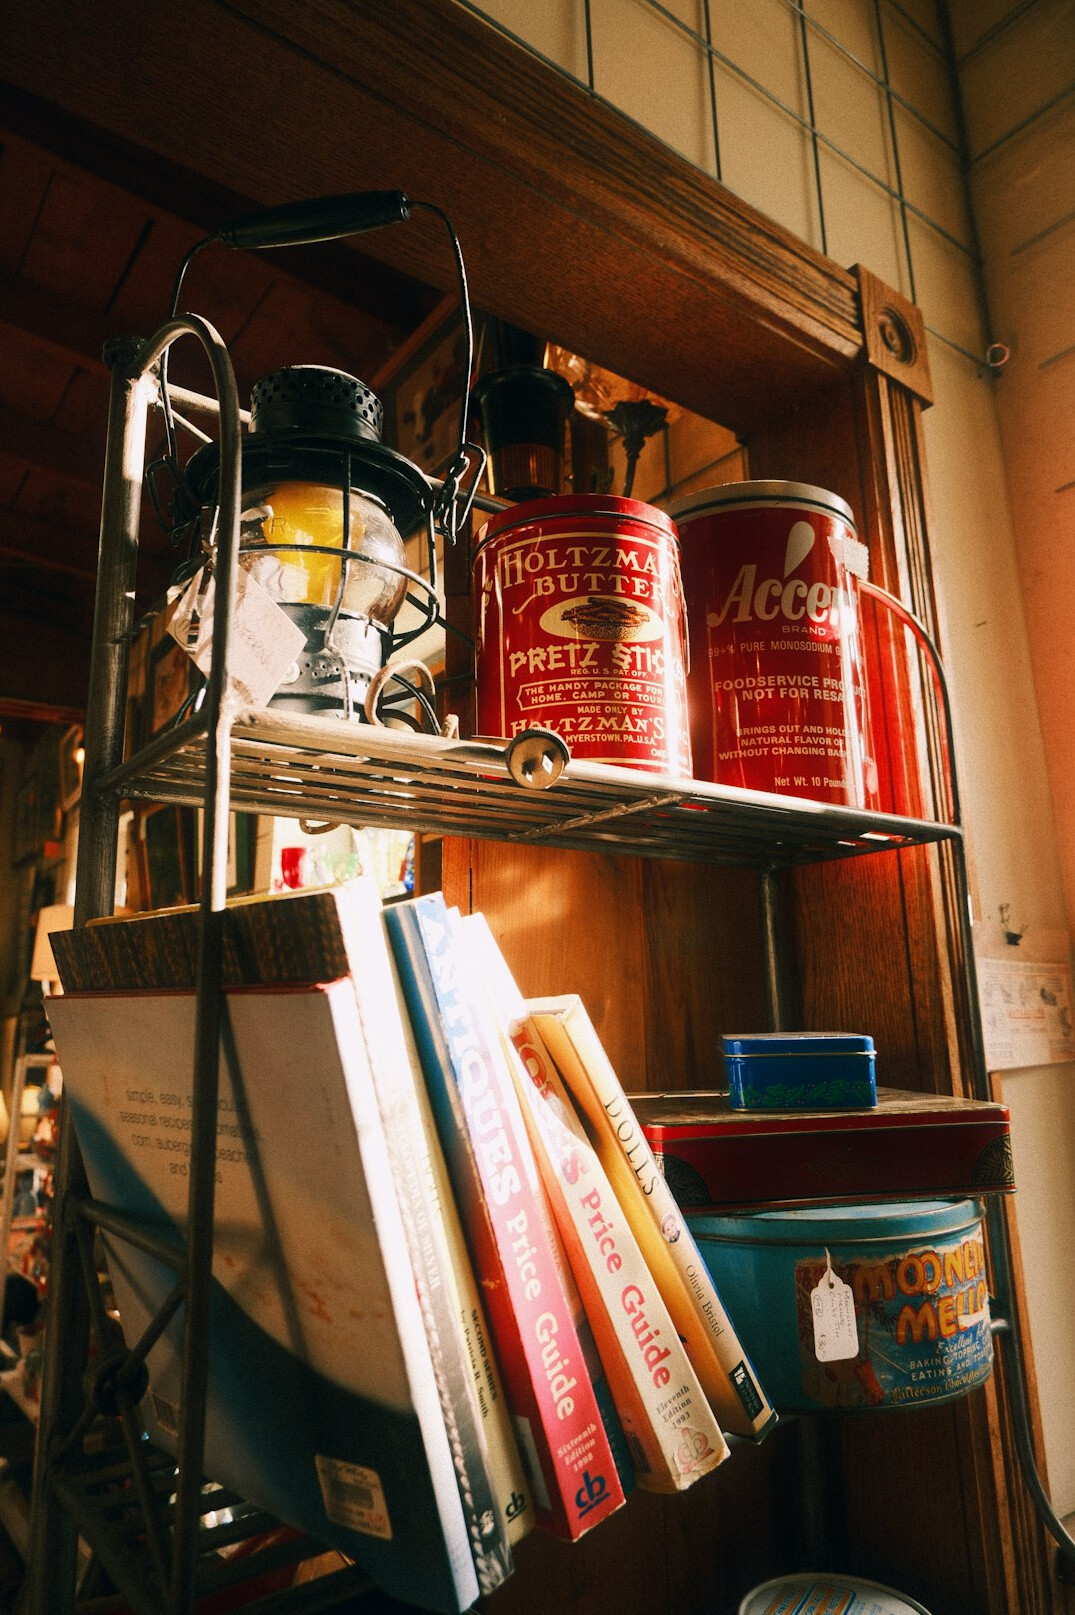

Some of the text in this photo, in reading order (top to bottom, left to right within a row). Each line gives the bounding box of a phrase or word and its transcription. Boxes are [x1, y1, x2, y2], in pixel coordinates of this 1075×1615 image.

[782, 626, 827, 636] BRAND
[740, 641, 766, 653] PURE
[771, 640, 833, 655] MONOSODIUM
[509, 641, 600, 678] PRETZ
[525, 681, 663, 696] THE HANDY PACKAGE FOR
[715, 675, 819, 692] FOODSERVICE
[572, 691, 605, 700] CAMP
[614, 691, 630, 700] OR
[742, 688, 775, 700] NOT
[780, 687, 808, 699] FOR
[631, 707, 643, 716] BY
[736, 725, 776, 737] BRINGS
[779, 725, 800, 733] OUT
[803, 725, 824, 734] AND
[741, 736, 792, 747] NATURAL
[794, 736, 832, 746] FLAVOR
[719, 748, 769, 761] WITHOUT
[772, 747, 826, 756] CHANGING
[774, 777, 790, 787] Net
[794, 777, 809, 787] Wt.
[811, 777, 821, 786] 10
[118, 1110, 157, 1127] seasonal
[605, 1102, 659, 1197] DOLLS
[169, 1161, 188, 1177] and
[580, 1187, 622, 1274] Price
[621, 1284, 672, 1390] Guide
[685, 1264, 725, 1338] Olivia Bristol
[507, 1209, 542, 1301] Price
[535, 1311, 578, 1421] Guide
[471, 1309, 487, 1357] SECOND
[464, 1327, 476, 1370] Patricia
[478, 1386, 489, 1419] Smith
[911, 1365, 952, 1382] EATING
[956, 1359, 971, 1371] AND
[656, 1385, 690, 1416] Eleventh
[662, 1397, 692, 1423] Edition
[672, 1411, 691, 1429] 1993
[557, 1422, 597, 1458] Sixteenth
[564, 1438, 596, 1466] Edition
